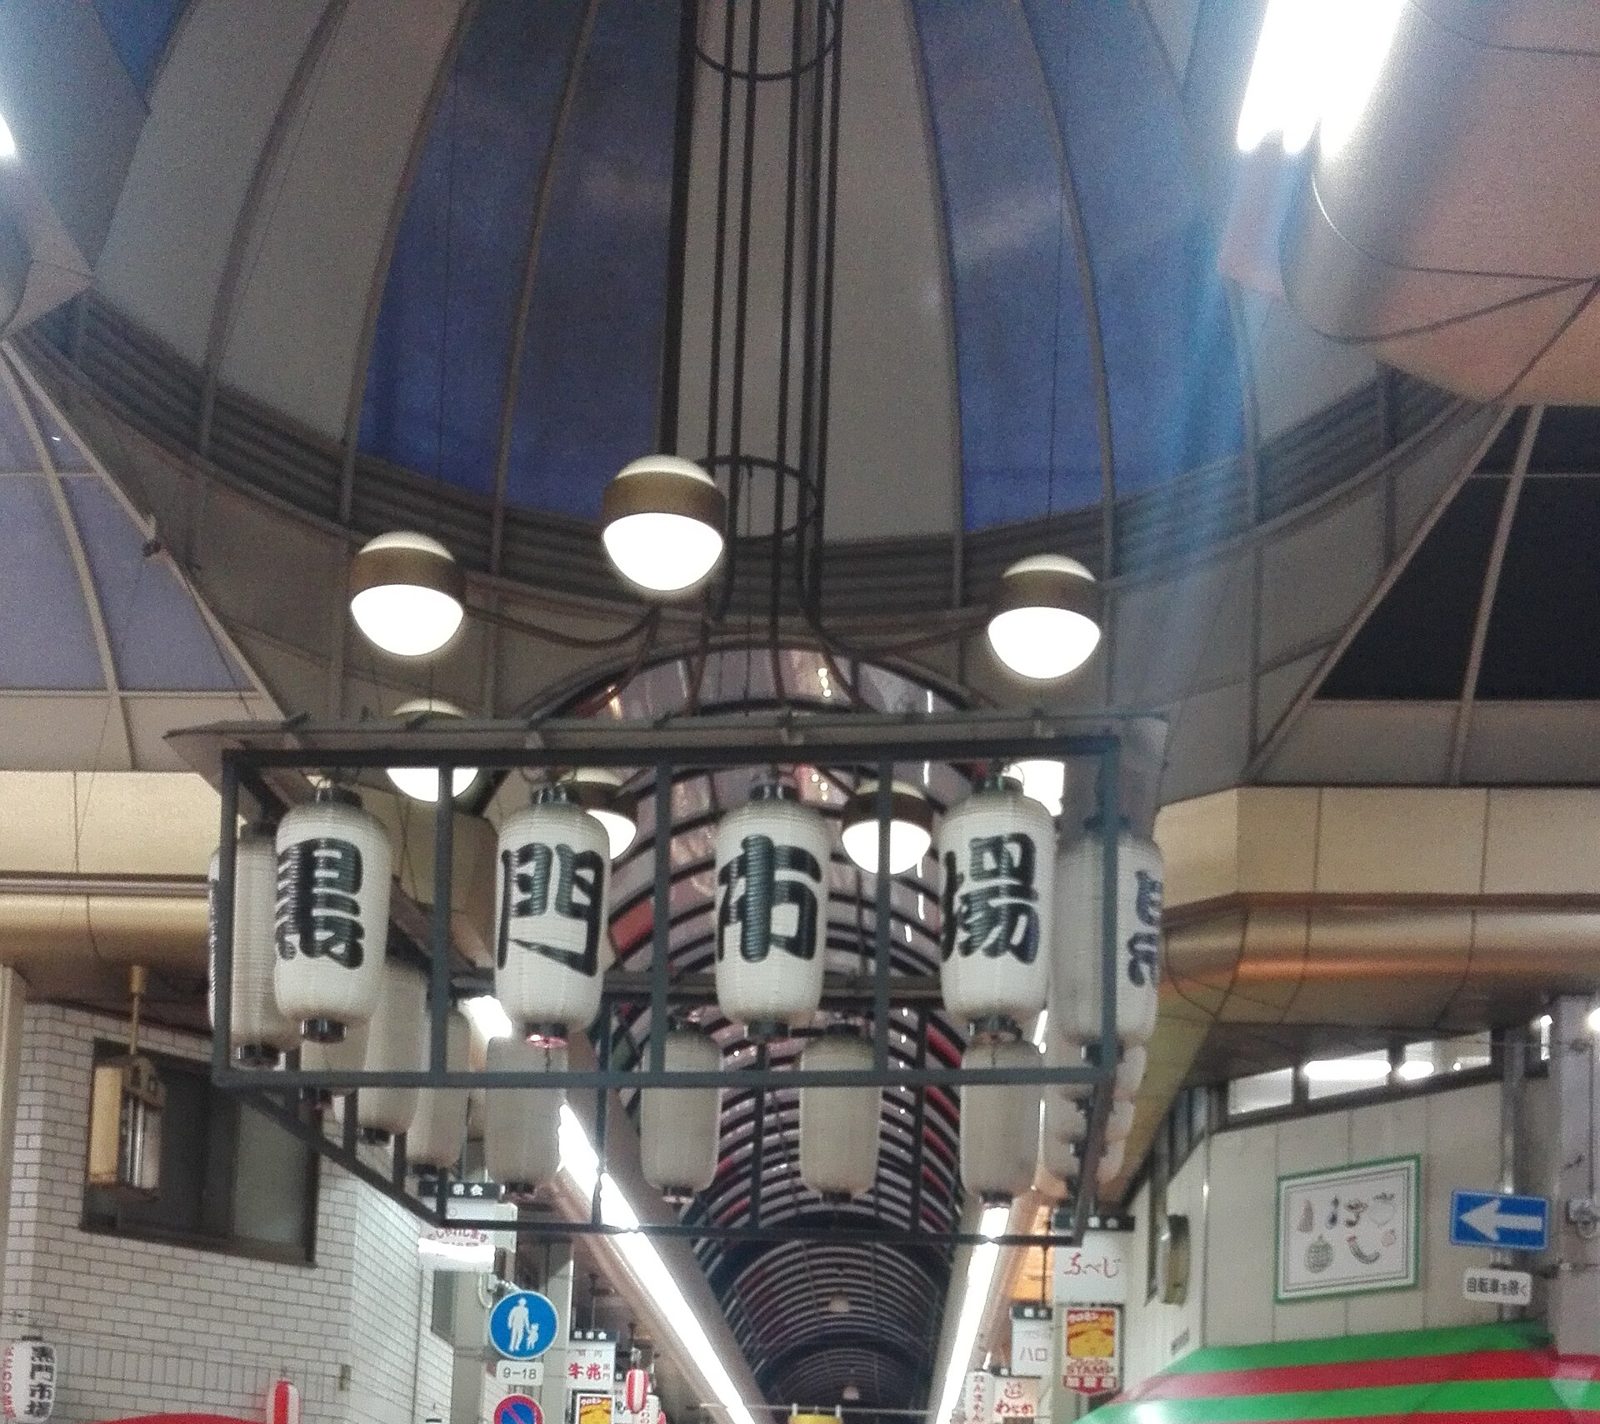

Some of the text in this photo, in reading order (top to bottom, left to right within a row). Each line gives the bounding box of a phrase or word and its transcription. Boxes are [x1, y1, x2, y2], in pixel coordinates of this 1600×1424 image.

[498, 842, 605, 977] 門
[717, 834, 823, 963] 市
[24, 1345, 56, 1418] 黒門市場
[503, 1367, 537, 1380] 9-18
